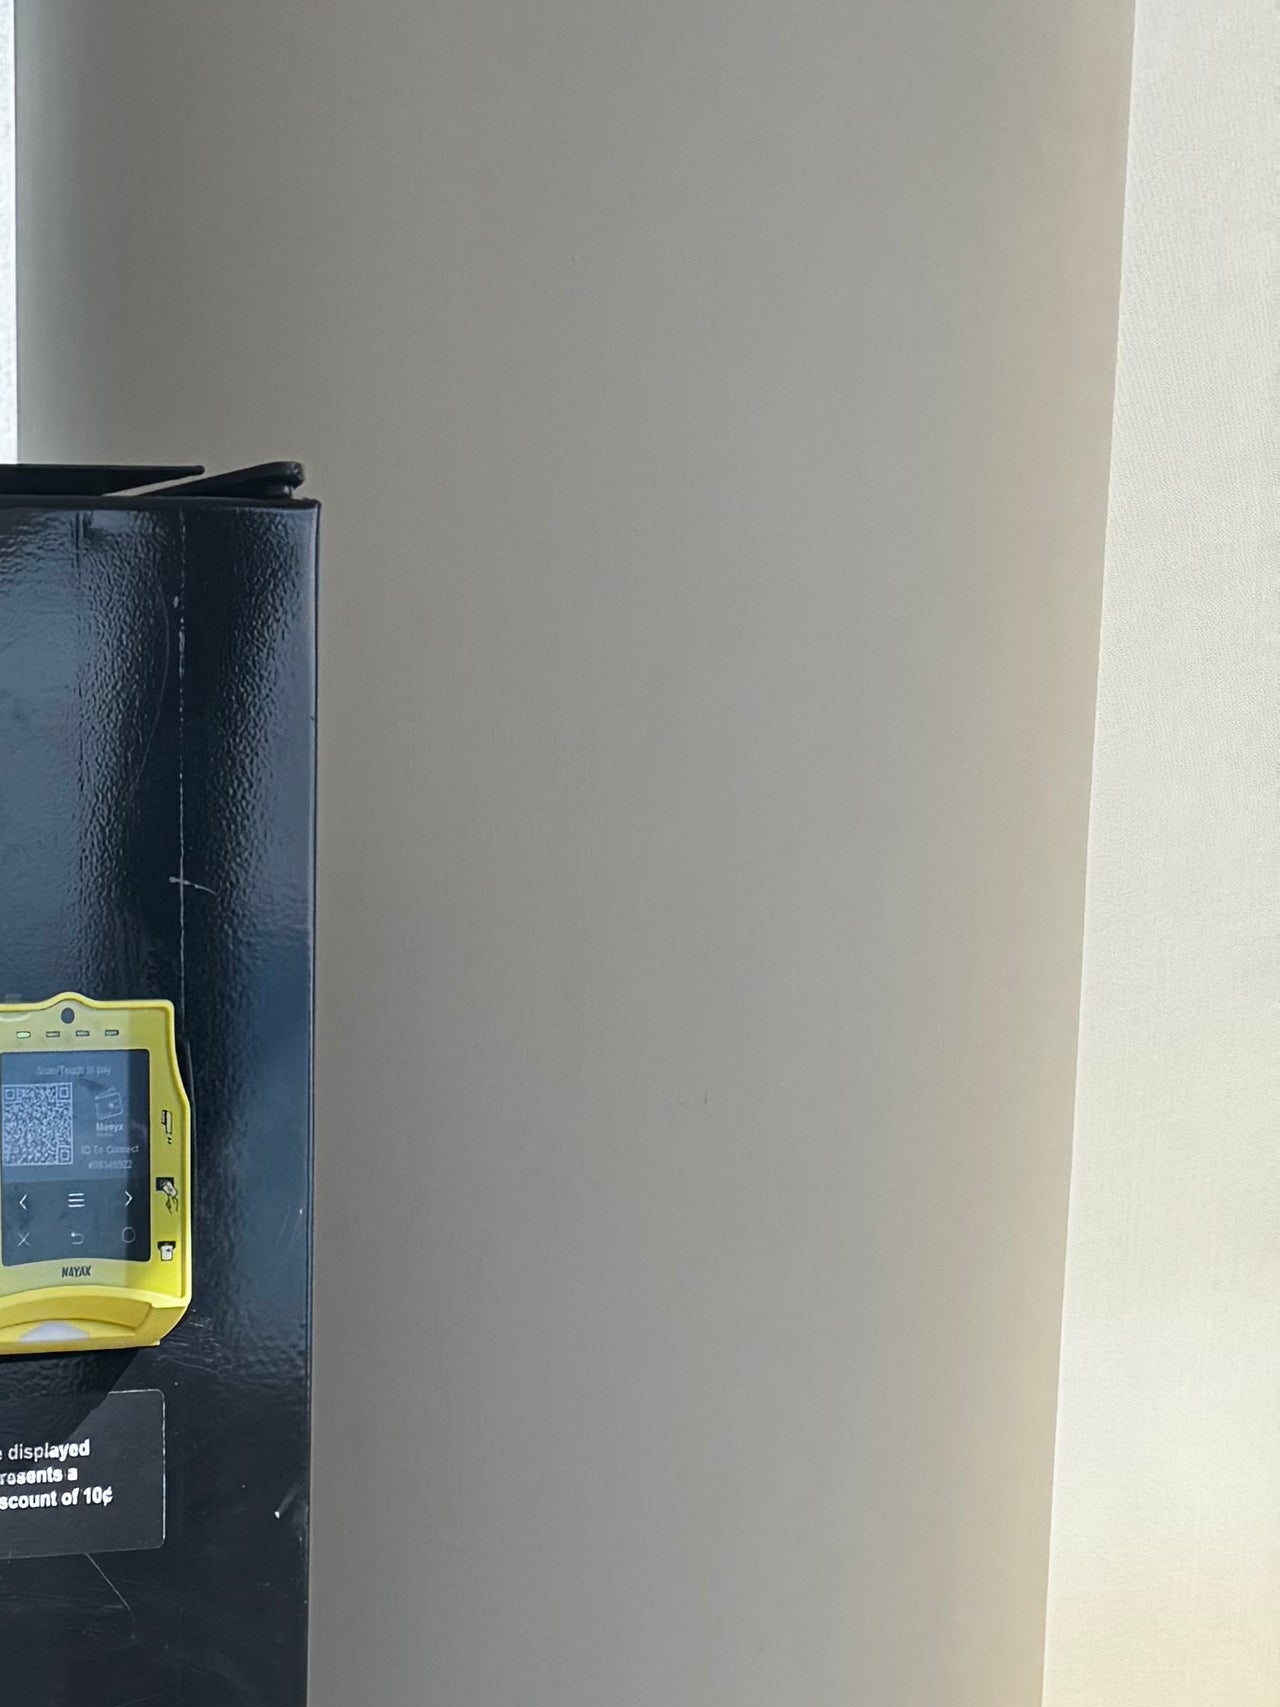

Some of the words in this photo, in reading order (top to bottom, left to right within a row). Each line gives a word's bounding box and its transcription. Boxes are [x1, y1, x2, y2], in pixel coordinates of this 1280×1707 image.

[62, 1266, 91, 1277] NAYAX
[8, 1439, 90, 1464] displayed
[68, 1467, 78, 1480] a
[62, 1487, 78, 1505] of
[83, 1486, 113, 1506] 10¢
